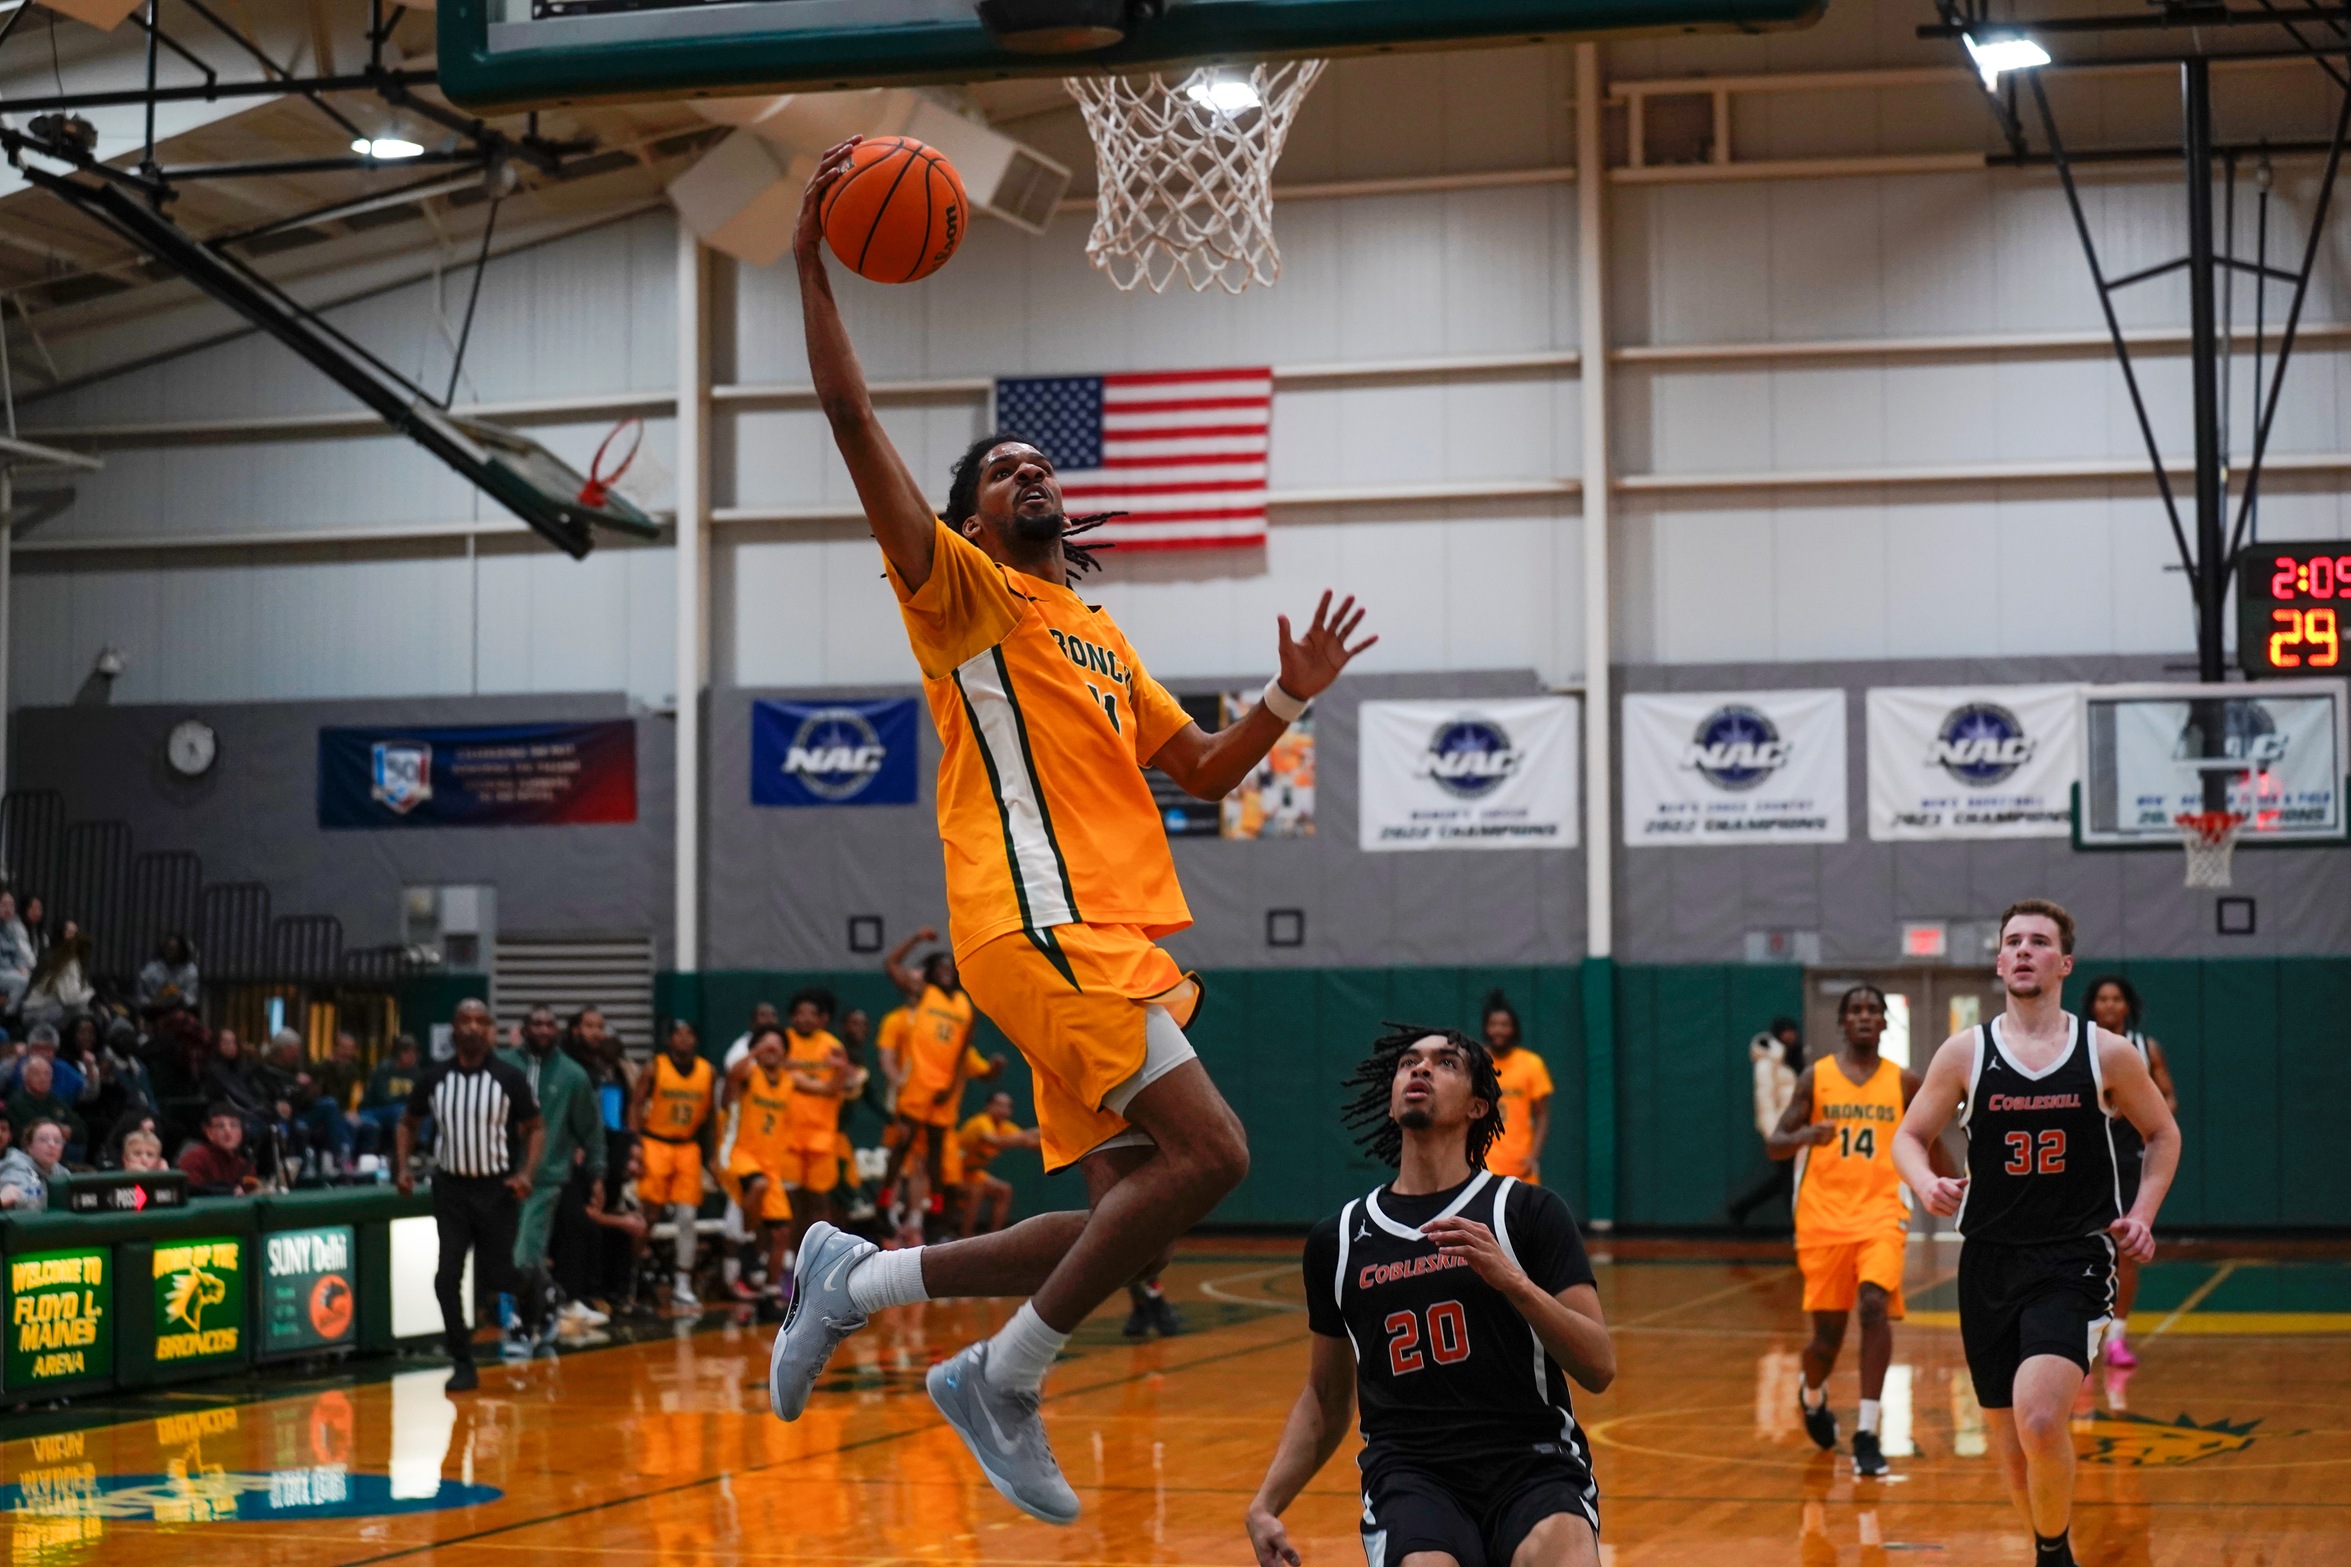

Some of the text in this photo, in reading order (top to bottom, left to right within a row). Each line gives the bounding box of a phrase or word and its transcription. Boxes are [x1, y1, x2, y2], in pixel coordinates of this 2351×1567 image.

[2270, 608, 2339, 667] 29
[781, 746, 887, 774] NAC
[1412, 749, 1525, 780] NAC
[1679, 741, 1792, 770] NAC
[1922, 737, 2037, 767] NAC
[1822, 1104, 1895, 1122] BRONCOS
[1840, 1126, 1875, 1160] 14
[2004, 1129, 2066, 1176] 32
[267, 1232, 347, 1276] SUNY Delhi
[12, 1256, 103, 1294] WELCOME TO
[14, 1291, 79, 1326] FLOYD
[19, 1317, 97, 1352] MAINES
[155, 1327, 239, 1361] BRONCOS
[1384, 1299, 1471, 1377] 20
[32, 1350, 85, 1378] ARENA
